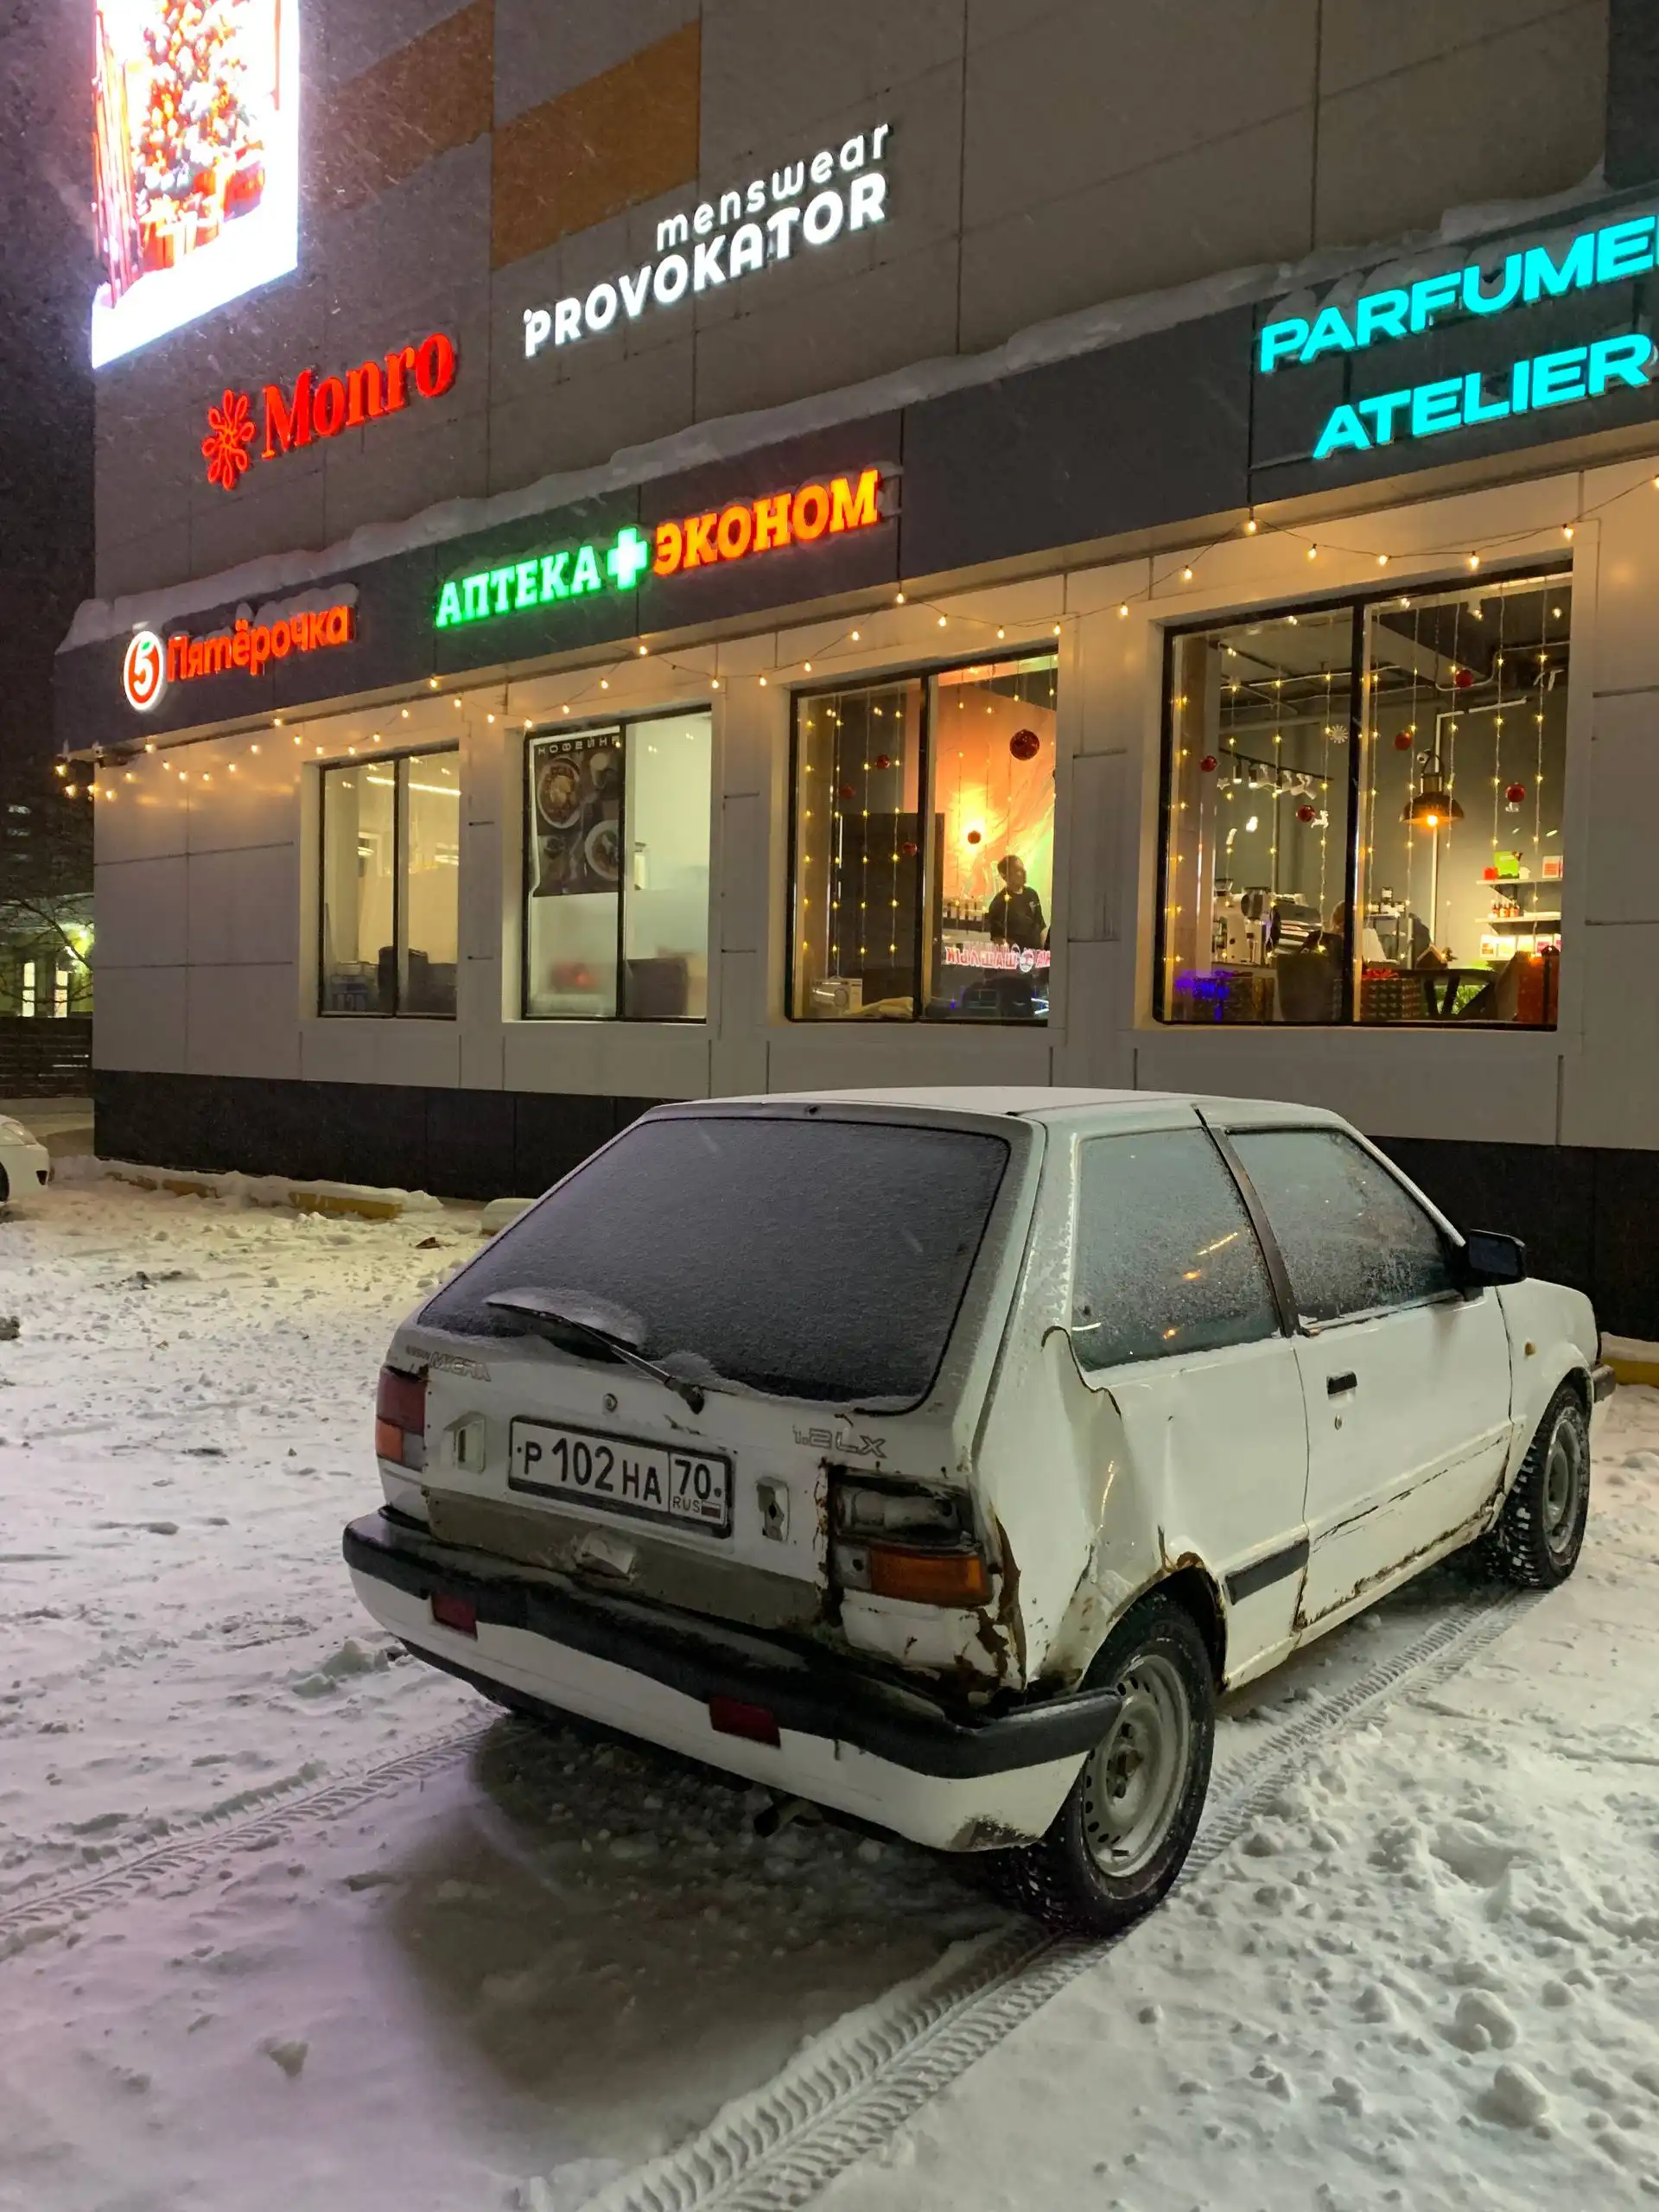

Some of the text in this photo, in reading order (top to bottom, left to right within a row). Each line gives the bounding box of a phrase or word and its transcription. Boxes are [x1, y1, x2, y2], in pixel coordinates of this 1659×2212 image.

[655, 123, 892, 252] menswear
[522, 171, 888, 359] PROVOKATOR
[1258, 214, 1659, 375] PARFUME
[261, 333, 455, 461] Monro
[1312, 333, 1654, 461] ATELIER
[434, 468, 881, 630] АПТЕКА ЭКОНОМ
[166, 604, 352, 683] Пятёрочка
[671, 1496, 702, 1515] RUS
[674, 1458, 712, 1501] 70
